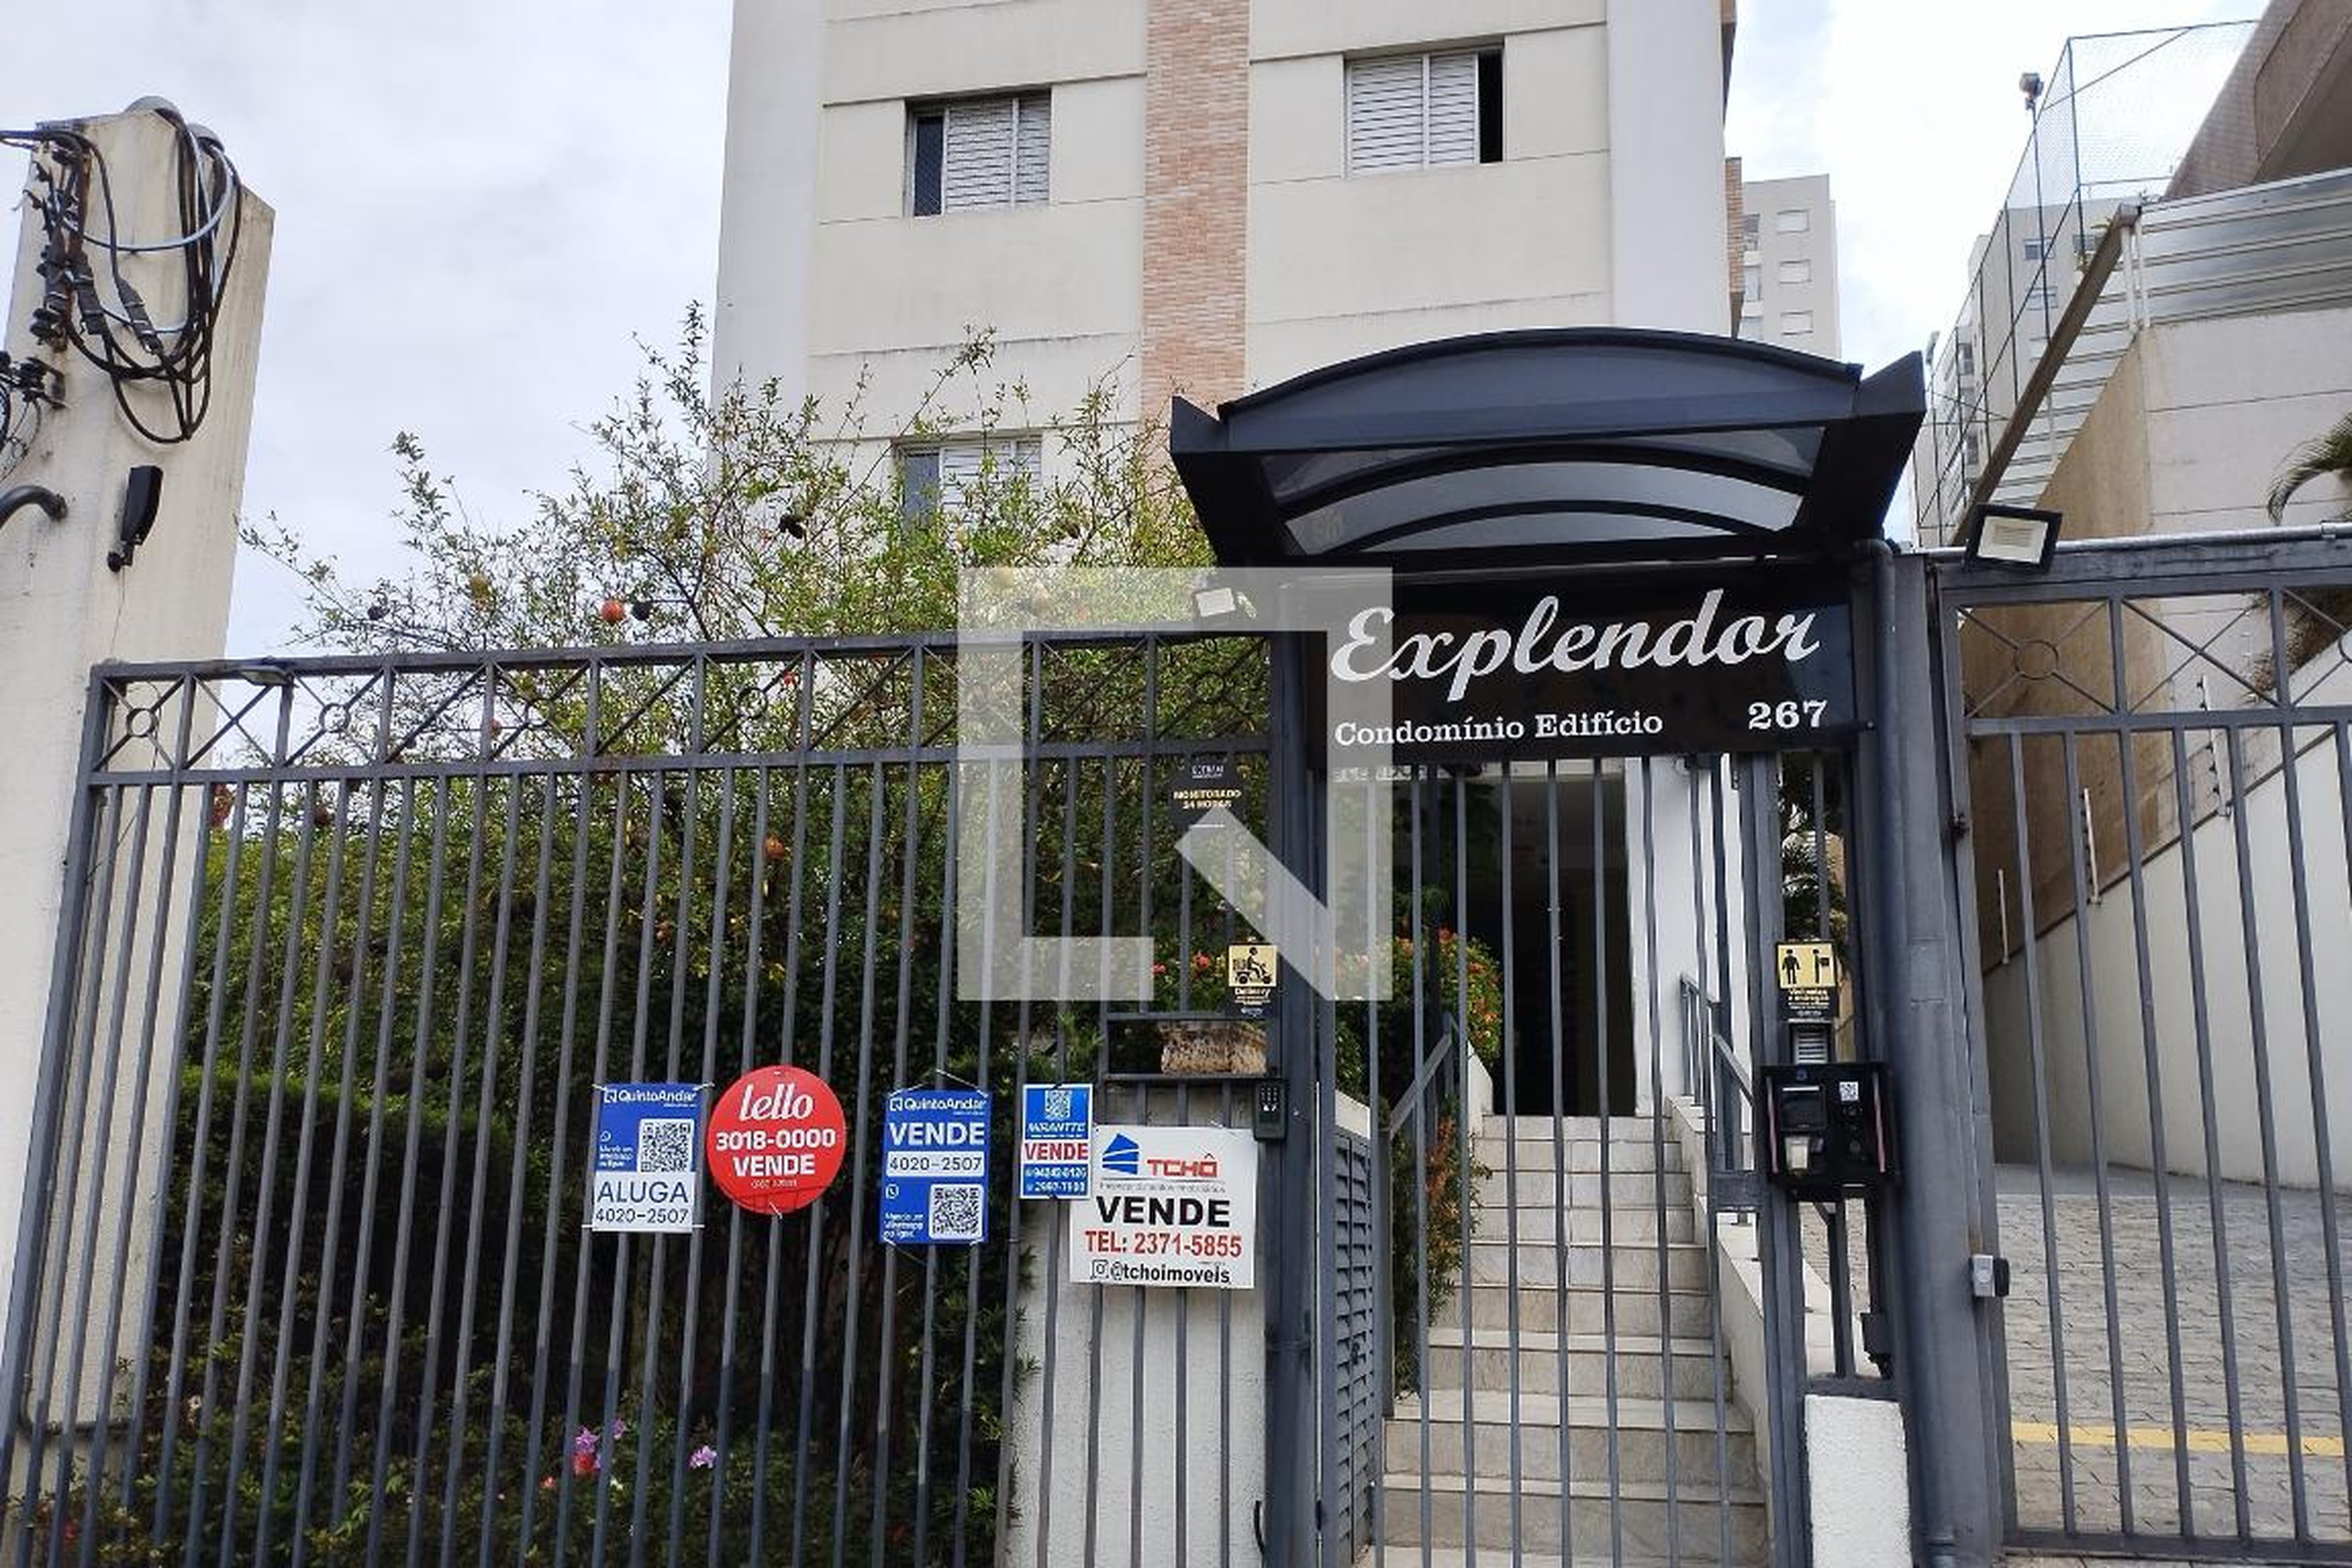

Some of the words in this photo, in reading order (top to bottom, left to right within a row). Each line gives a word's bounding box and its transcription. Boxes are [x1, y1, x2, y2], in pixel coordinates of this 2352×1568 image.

[1330, 588, 1820, 702] Explendor
[1748, 699, 1828, 730] 267
[1335, 716, 1525, 745] Condomínio
[1534, 710, 1664, 737] Edifício
[618, 1090, 696, 1102] QuintoAndar
[739, 1083, 813, 1121] lello
[904, 1098, 987, 1111] QuintoAndar
[716, 1128, 836, 1151] 3018-0000
[889, 1122, 985, 1145] VENDE
[1024, 1143, 1088, 1159] VENDE
[733, 1153, 815, 1177] VENDE
[889, 1156, 982, 1171] 4020-2507
[1147, 1153, 1218, 1177] TCHÔ
[597, 1181, 688, 1203] ALUGA
[596, 1208, 688, 1223] 4020-2507
[1096, 1196, 1230, 1227] VENDE
[1085, 1231, 1127, 1253] TEL:
[1134, 1232, 1242, 1257] 2371-5855
[1110, 1261, 1231, 1283] @tchoimoveis
